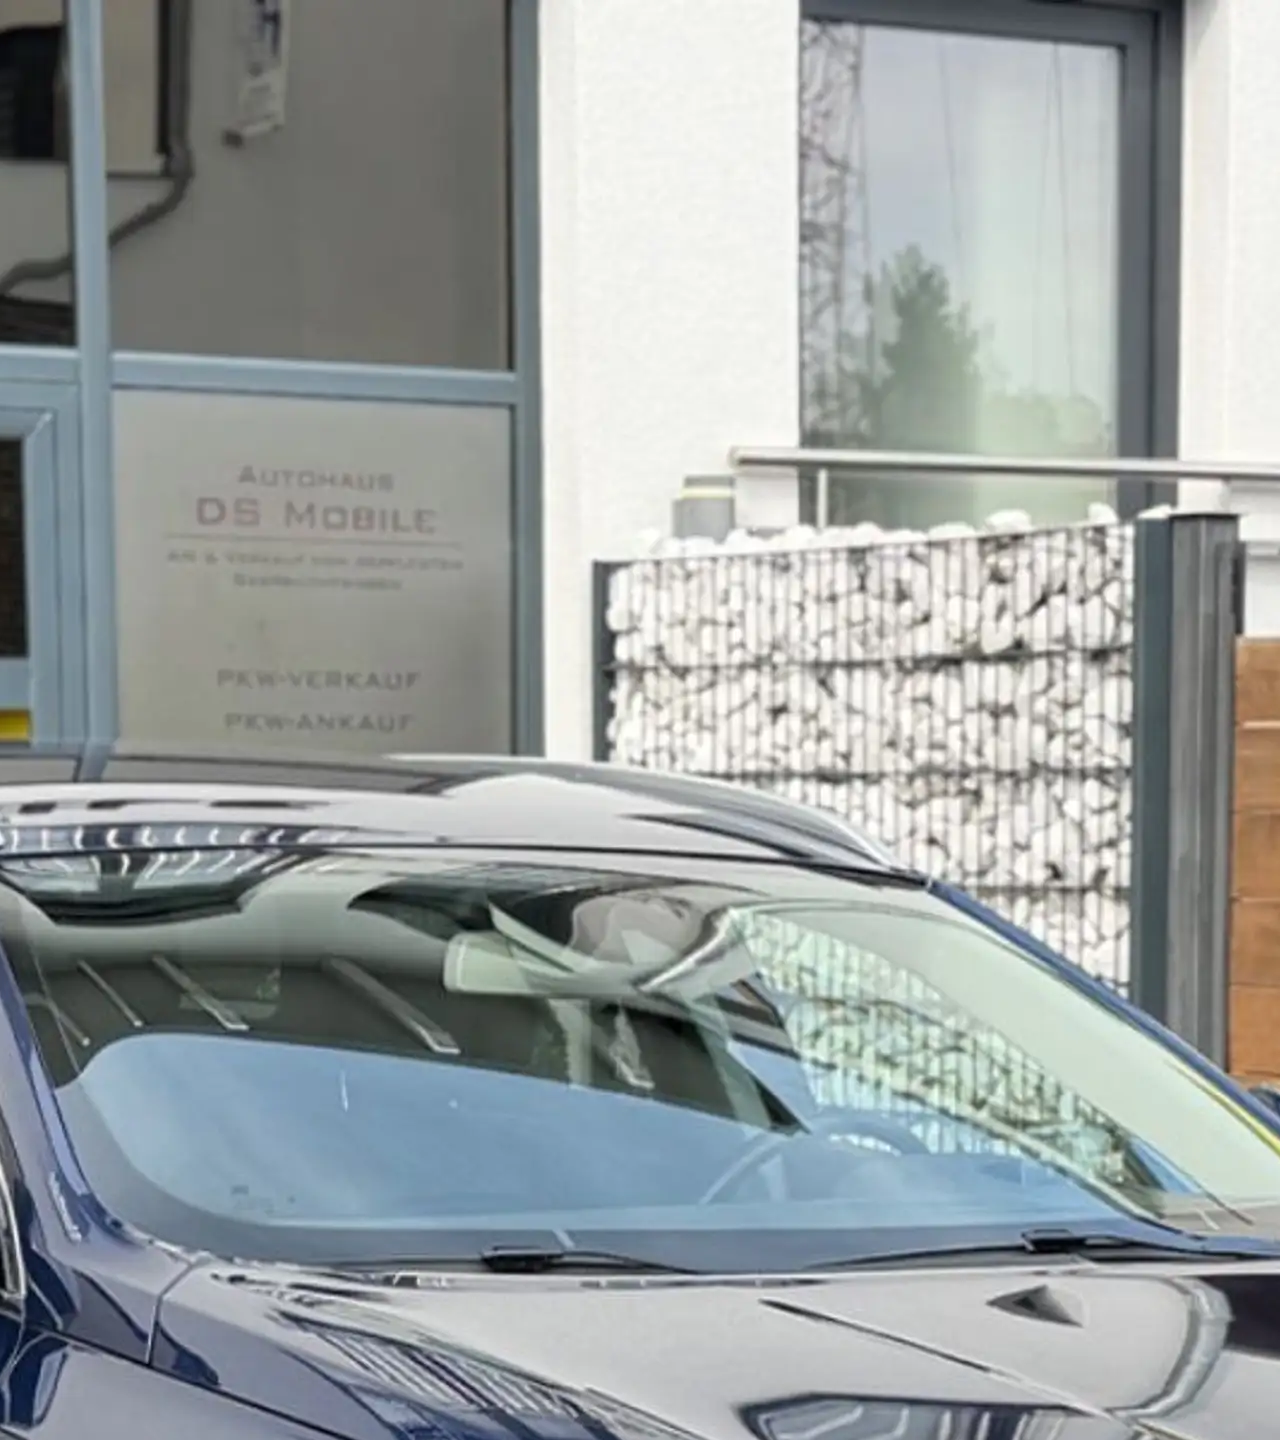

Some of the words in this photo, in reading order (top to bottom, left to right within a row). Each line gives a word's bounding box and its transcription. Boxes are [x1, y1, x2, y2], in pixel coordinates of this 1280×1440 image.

[196, 497, 261, 526] DS
[217, 668, 420, 691] PKW-VERKAUF
[225, 711, 414, 733] PKW-ANKAUF
